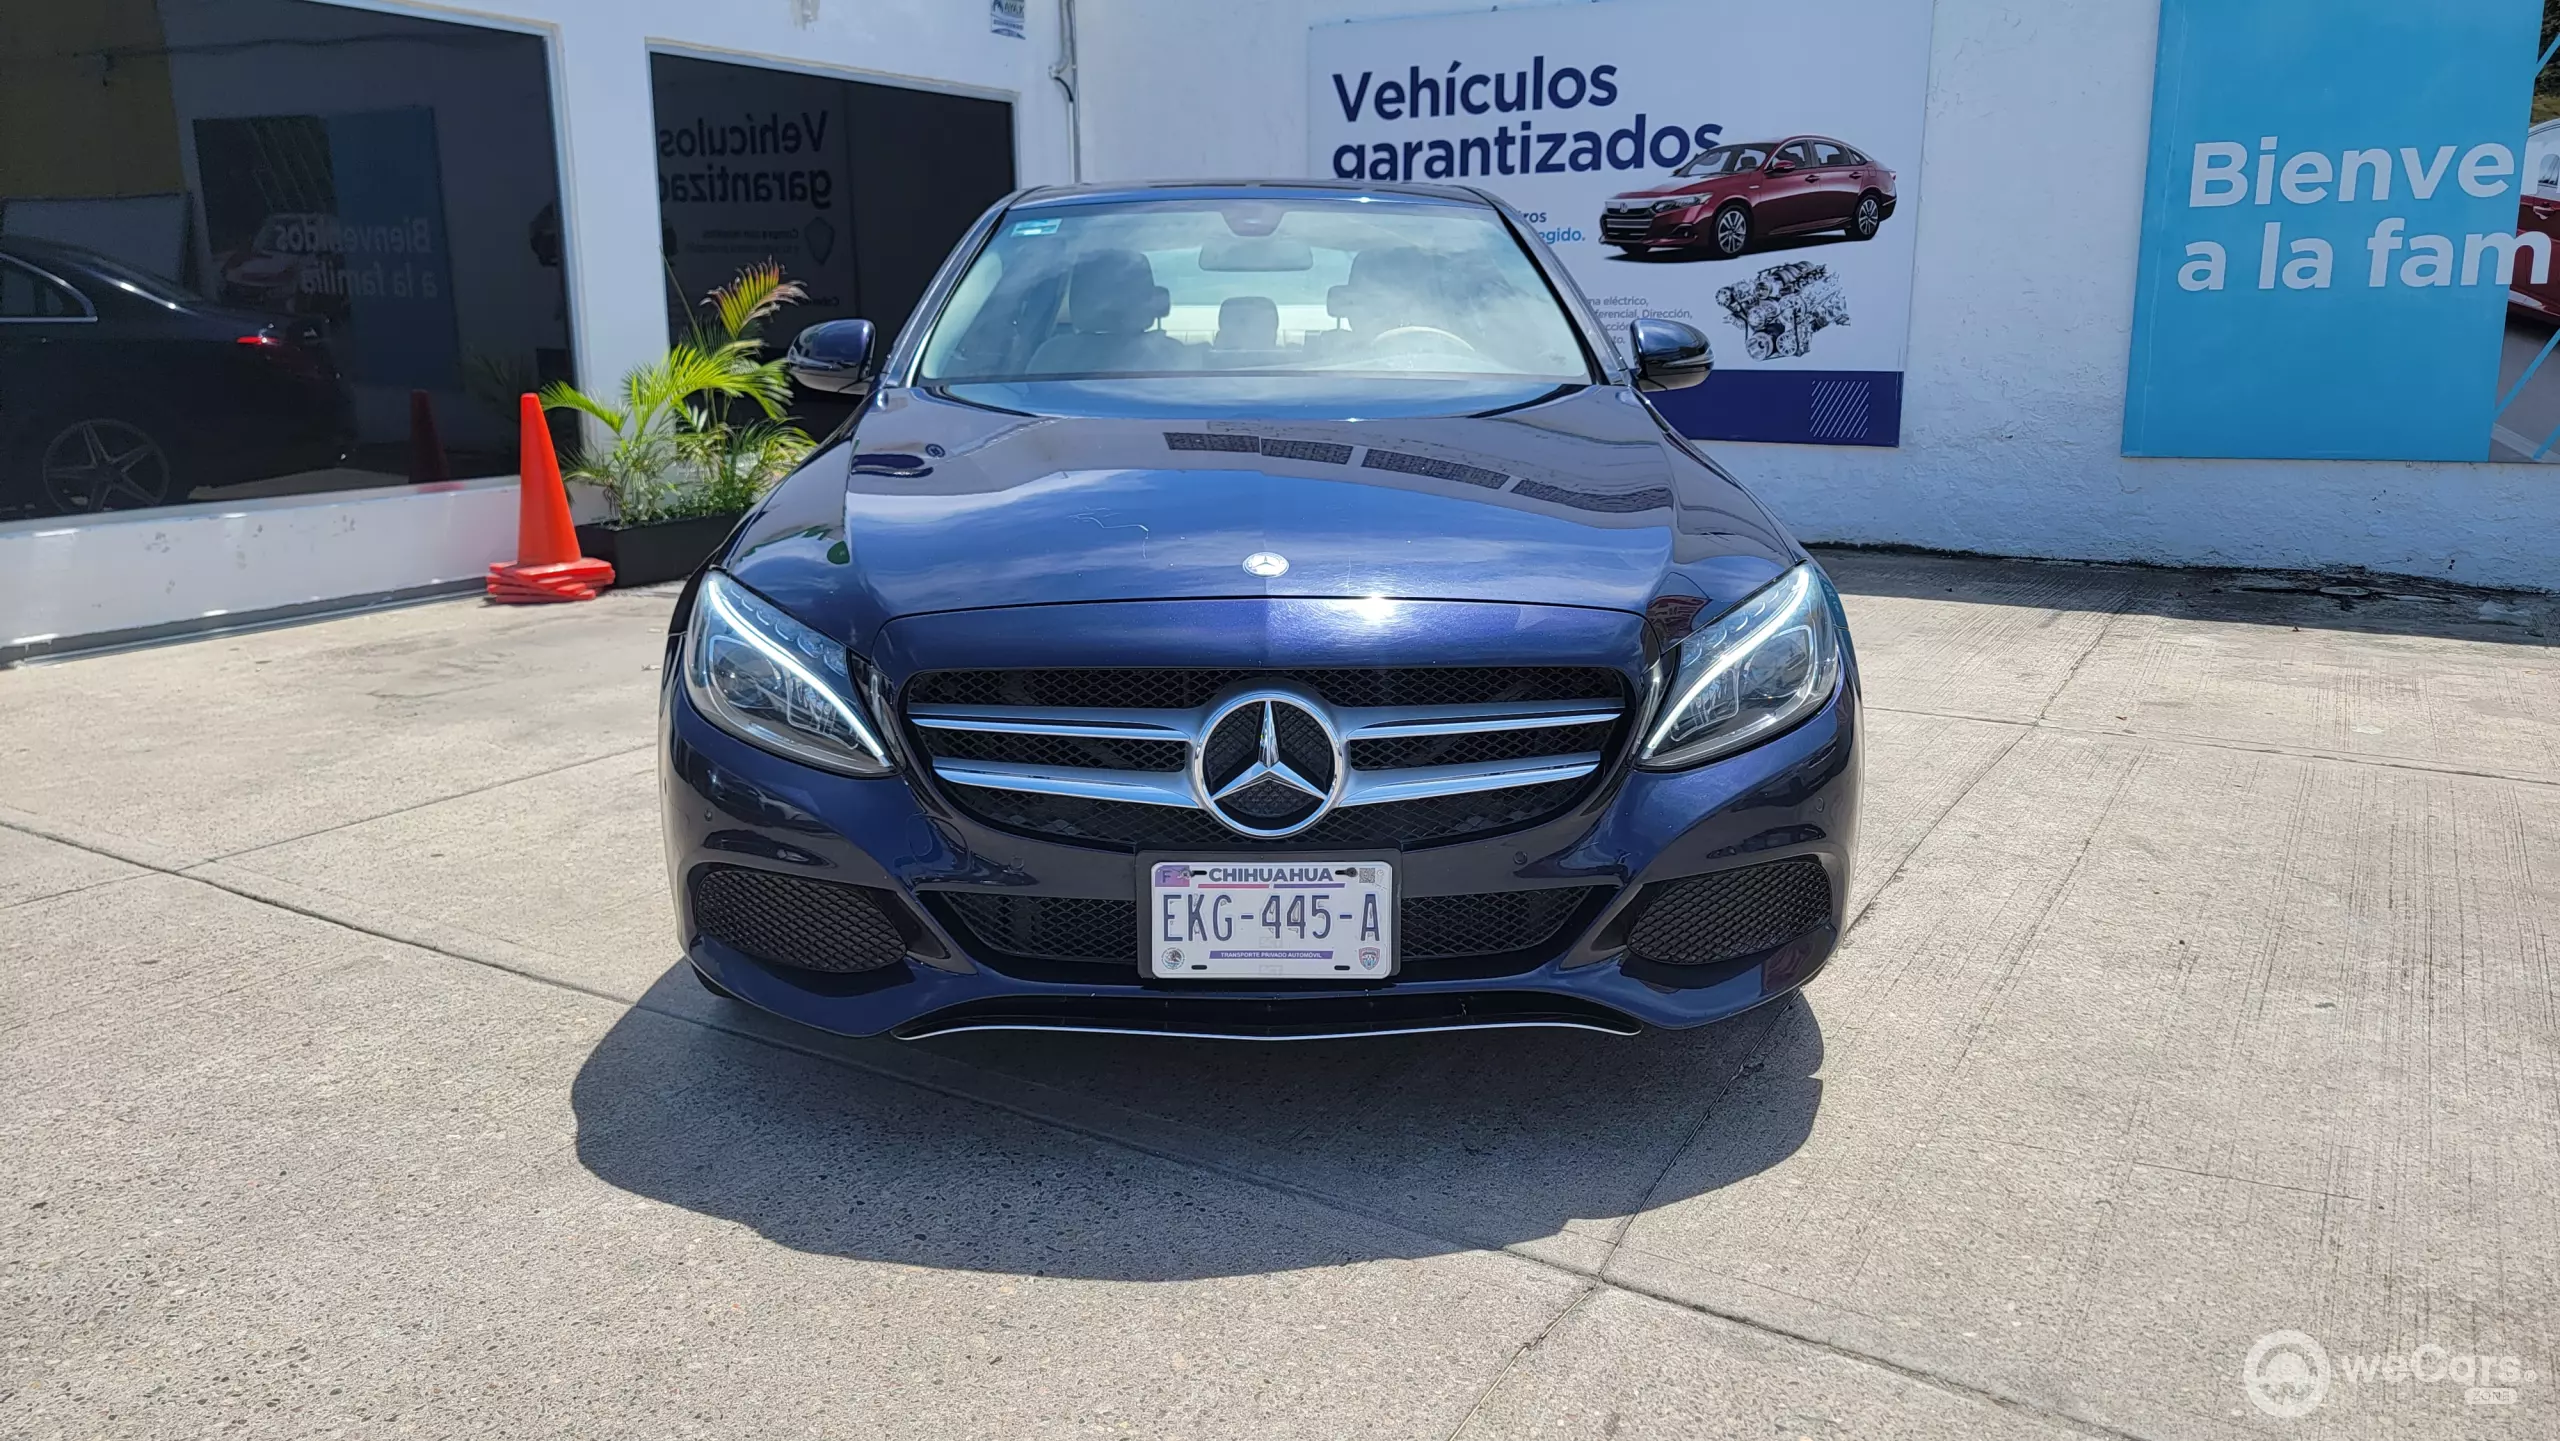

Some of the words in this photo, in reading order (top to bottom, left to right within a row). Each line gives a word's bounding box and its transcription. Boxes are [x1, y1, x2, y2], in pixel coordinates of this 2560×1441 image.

[1332, 55, 1618, 123] Vehículos
[1332, 113, 1723, 182] garantizados
[2177, 239, 2227, 292] a
[2258, 221, 2334, 290] la
[2366, 217, 2552, 289] fam
[1603, 296, 1649, 307] eléctrico,
[1642, 308, 1693, 319] Dirección,
[1208, 867, 1335, 883] CHIHUAHUA
[1162, 893, 1381, 942] EKG-445-A
